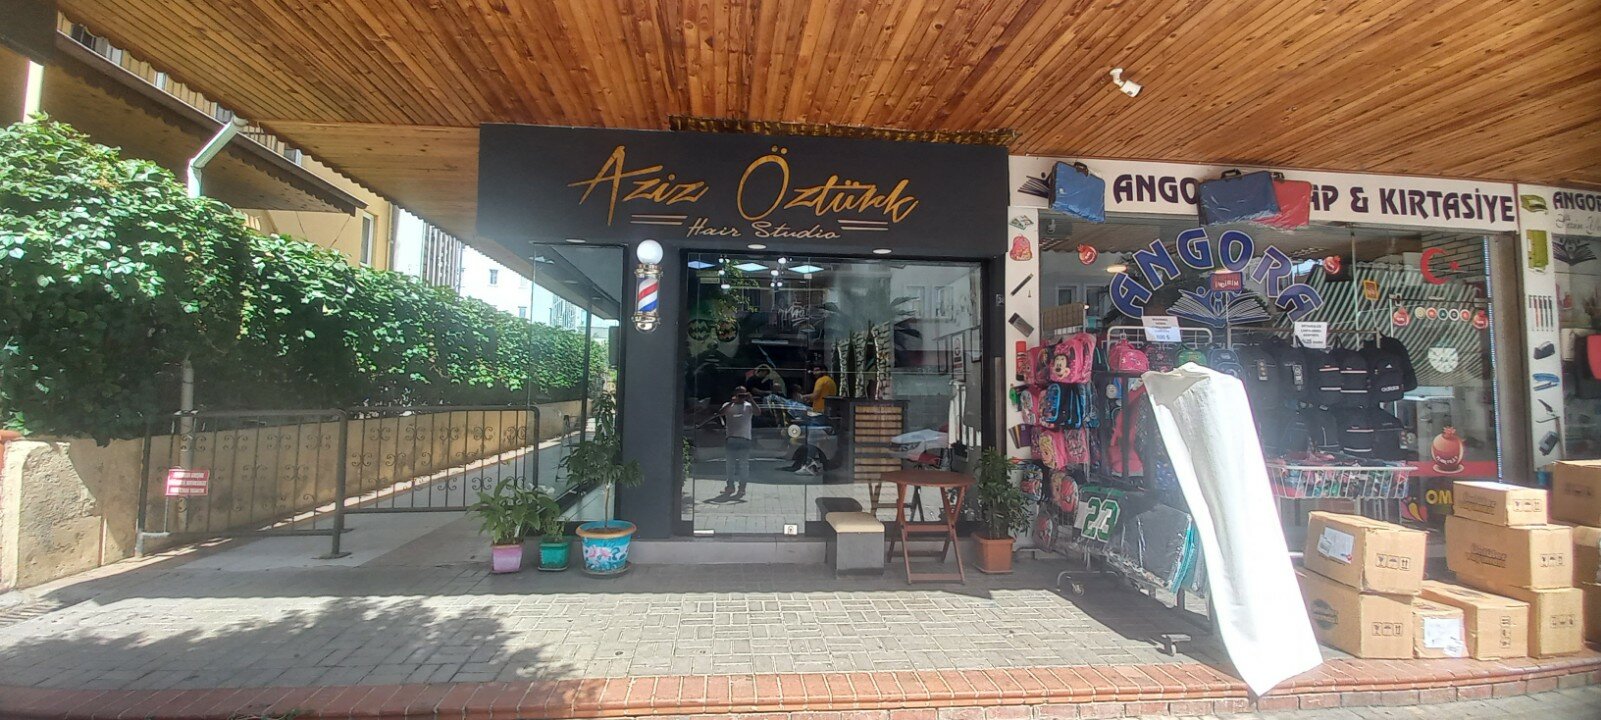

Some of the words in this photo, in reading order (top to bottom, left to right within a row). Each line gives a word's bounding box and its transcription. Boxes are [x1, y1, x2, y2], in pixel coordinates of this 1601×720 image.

[568, 145, 709, 226] Aziz
[737, 145, 919, 223] Öztürk
[1113, 174, 1199, 204] ANGO
[1350, 187, 1369, 213] &
[1379, 187, 1515, 224] KIRTASİYE
[687, 218, 741, 238] Hair
[751, 220, 841, 239] Studio
[1109, 228, 1324, 324] ANGORA
[1081, 496, 1120, 543] 23
